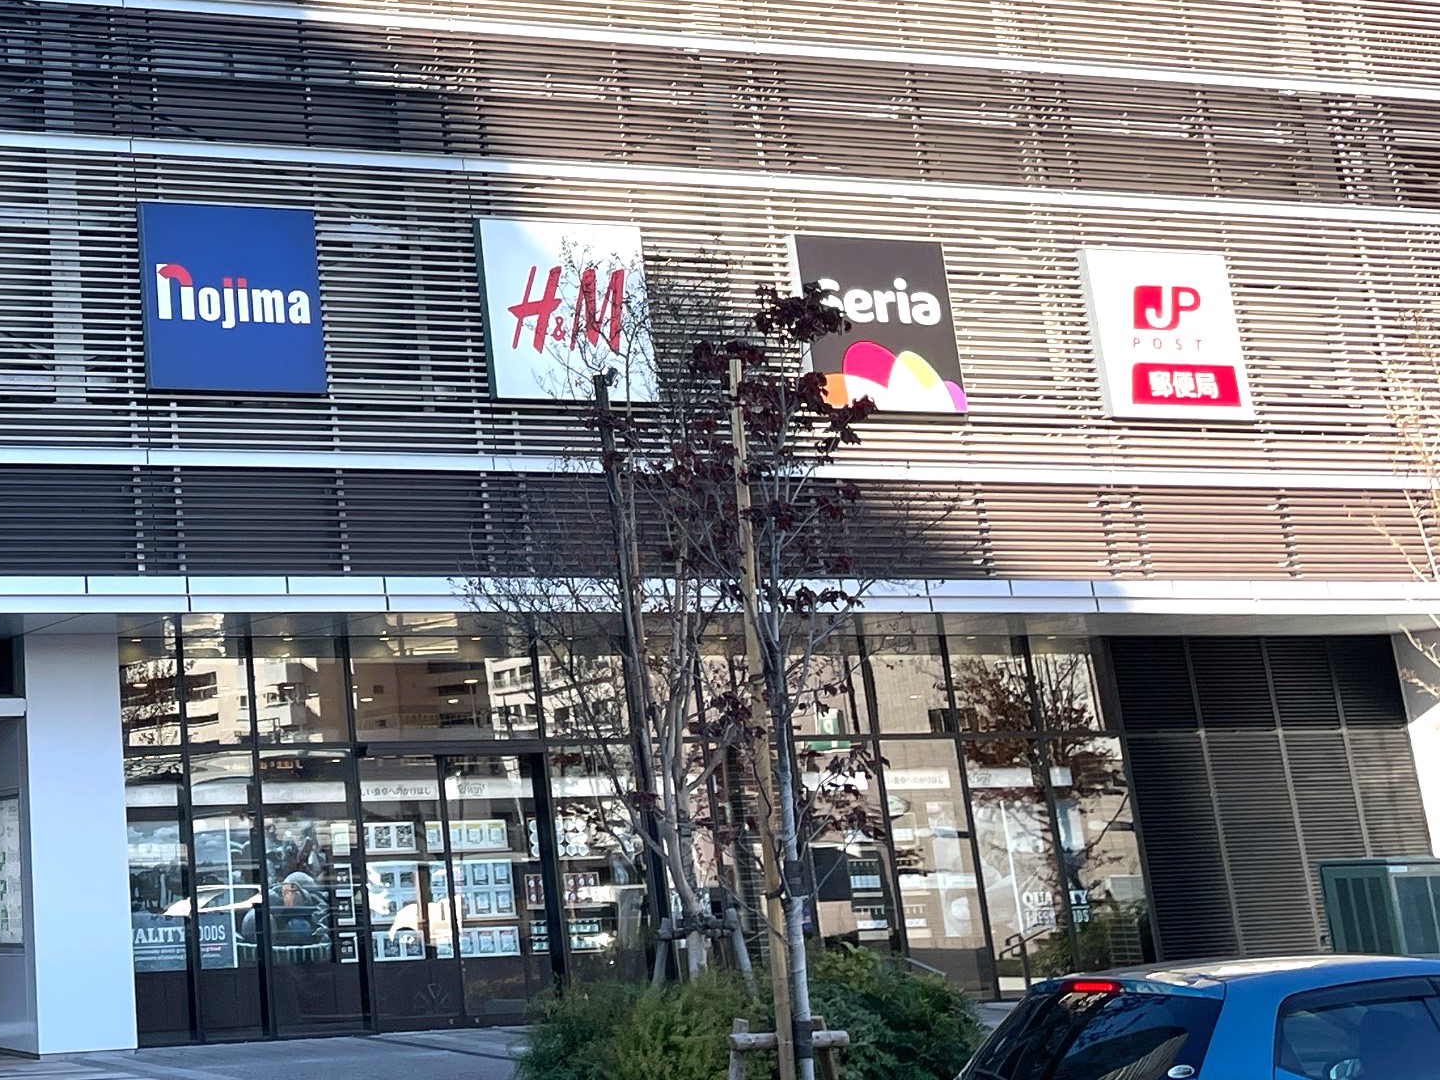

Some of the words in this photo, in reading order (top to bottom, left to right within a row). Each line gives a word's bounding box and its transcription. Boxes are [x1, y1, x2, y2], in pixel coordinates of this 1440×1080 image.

[155, 262, 312, 329] nojima
[507, 265, 626, 357] H&M
[1132, 337, 1203, 351] POST
[1148, 370, 1220, 400] 郵便局
